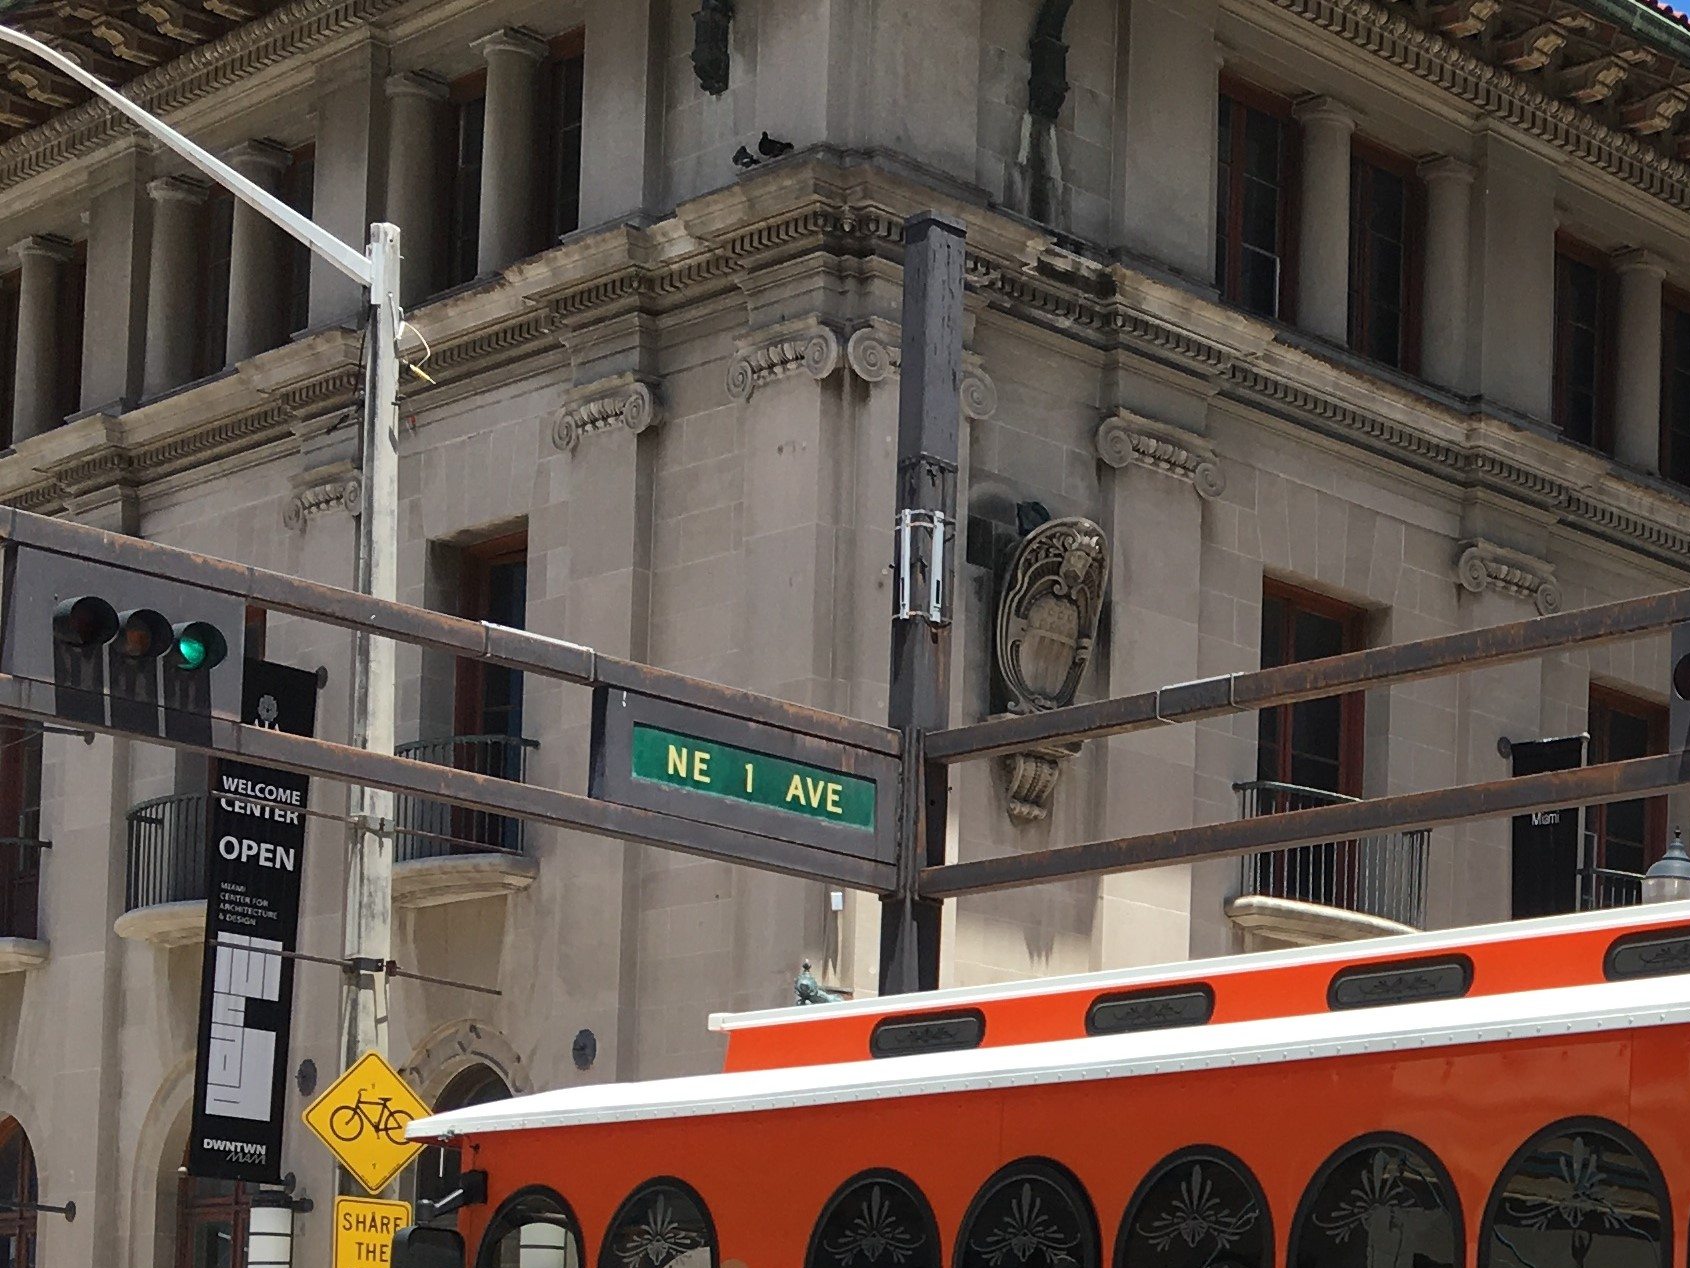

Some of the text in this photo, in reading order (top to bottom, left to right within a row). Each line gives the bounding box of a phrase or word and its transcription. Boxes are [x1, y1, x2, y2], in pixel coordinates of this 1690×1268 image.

[667, 745, 843, 814] NE 1 AVE
[222, 775, 301, 806] WELCOME
[220, 798, 299, 825] CENTER
[219, 835, 295, 872] OPEN
[219, 892, 269, 907] CENTER FOR
[219, 902, 278, 920] ARCHITECTURE
[225, 914, 256, 926] DESIGN
[203, 1138, 266, 1155] DWNTWN
[355, 1242, 390, 1262] THE
